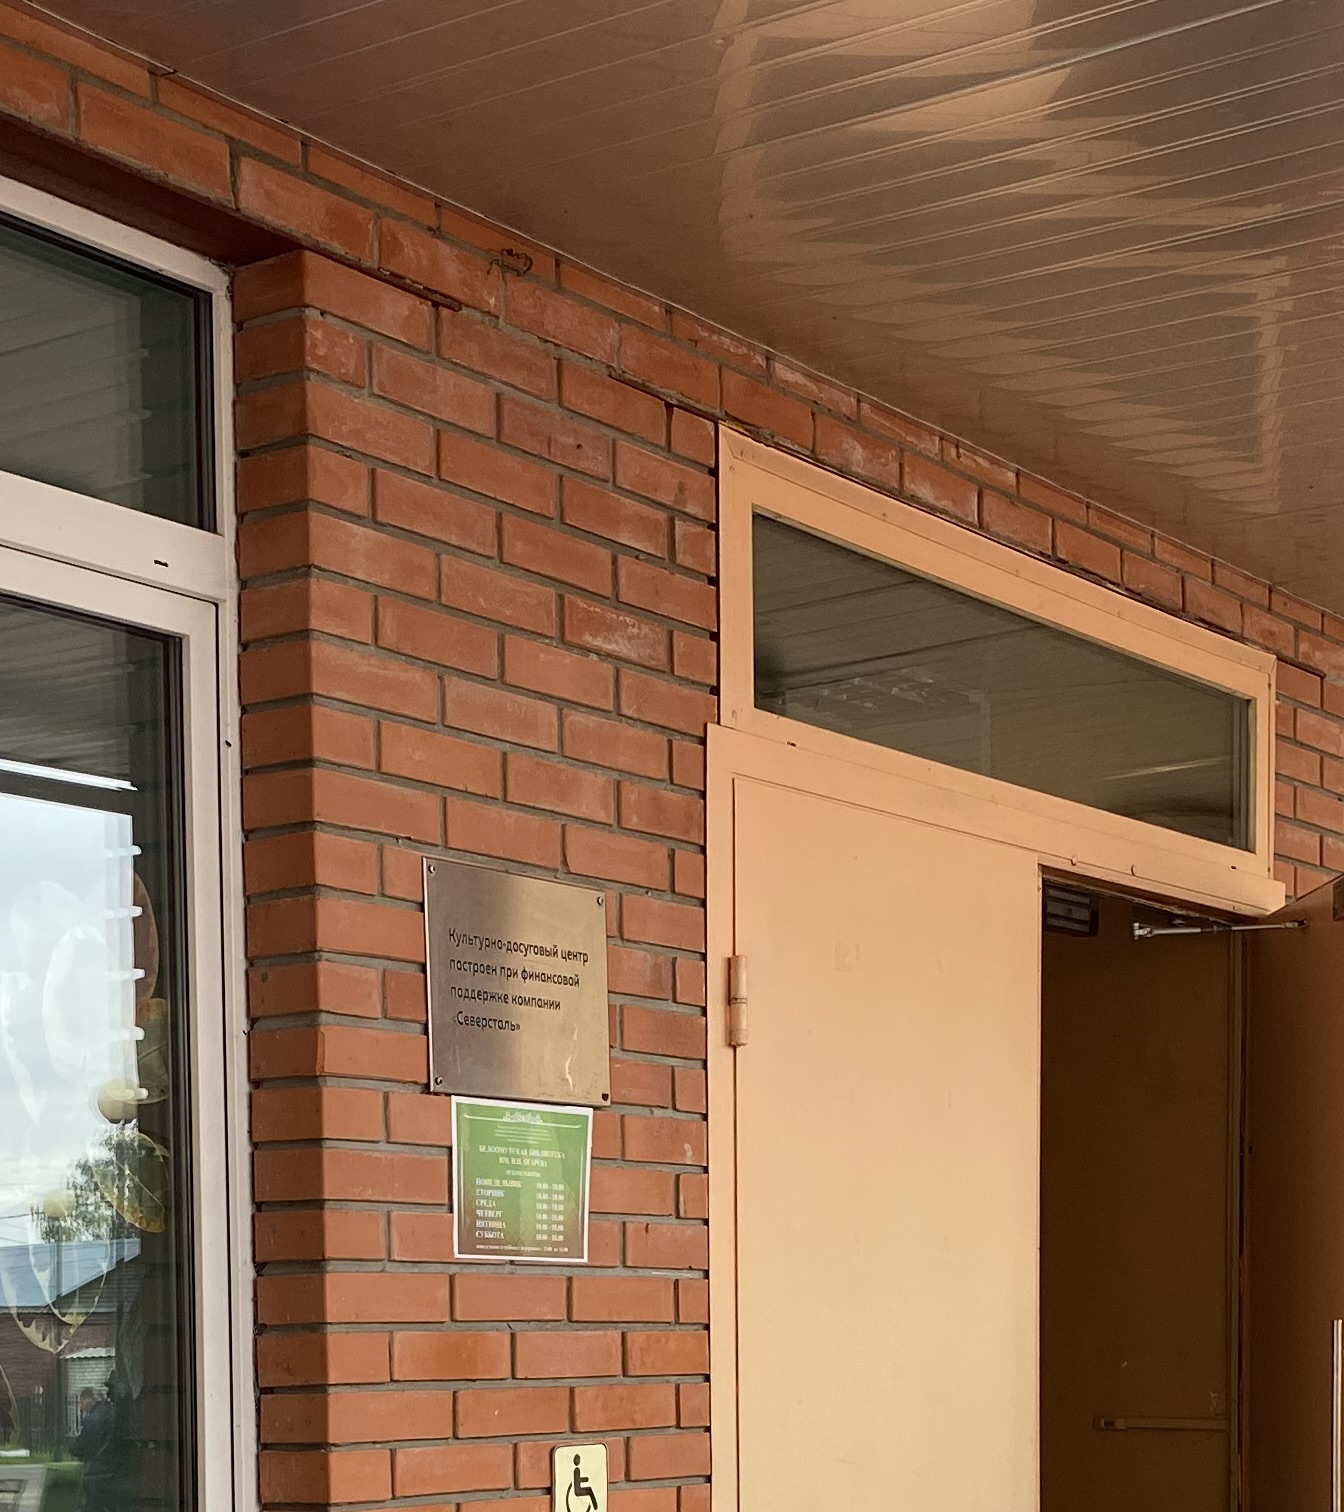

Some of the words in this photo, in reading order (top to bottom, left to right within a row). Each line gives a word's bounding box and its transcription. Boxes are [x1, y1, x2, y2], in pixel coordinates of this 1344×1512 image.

[449, 928, 558, 958] Культурно-досуговый
[561, 949, 588, 966] центр
[449, 959, 497, 976] построен
[500, 966, 518, 980] при
[521, 966, 580, 987] финансовой
[450, 986, 508, 1004] поддержке
[511, 993, 561, 1011] компании
